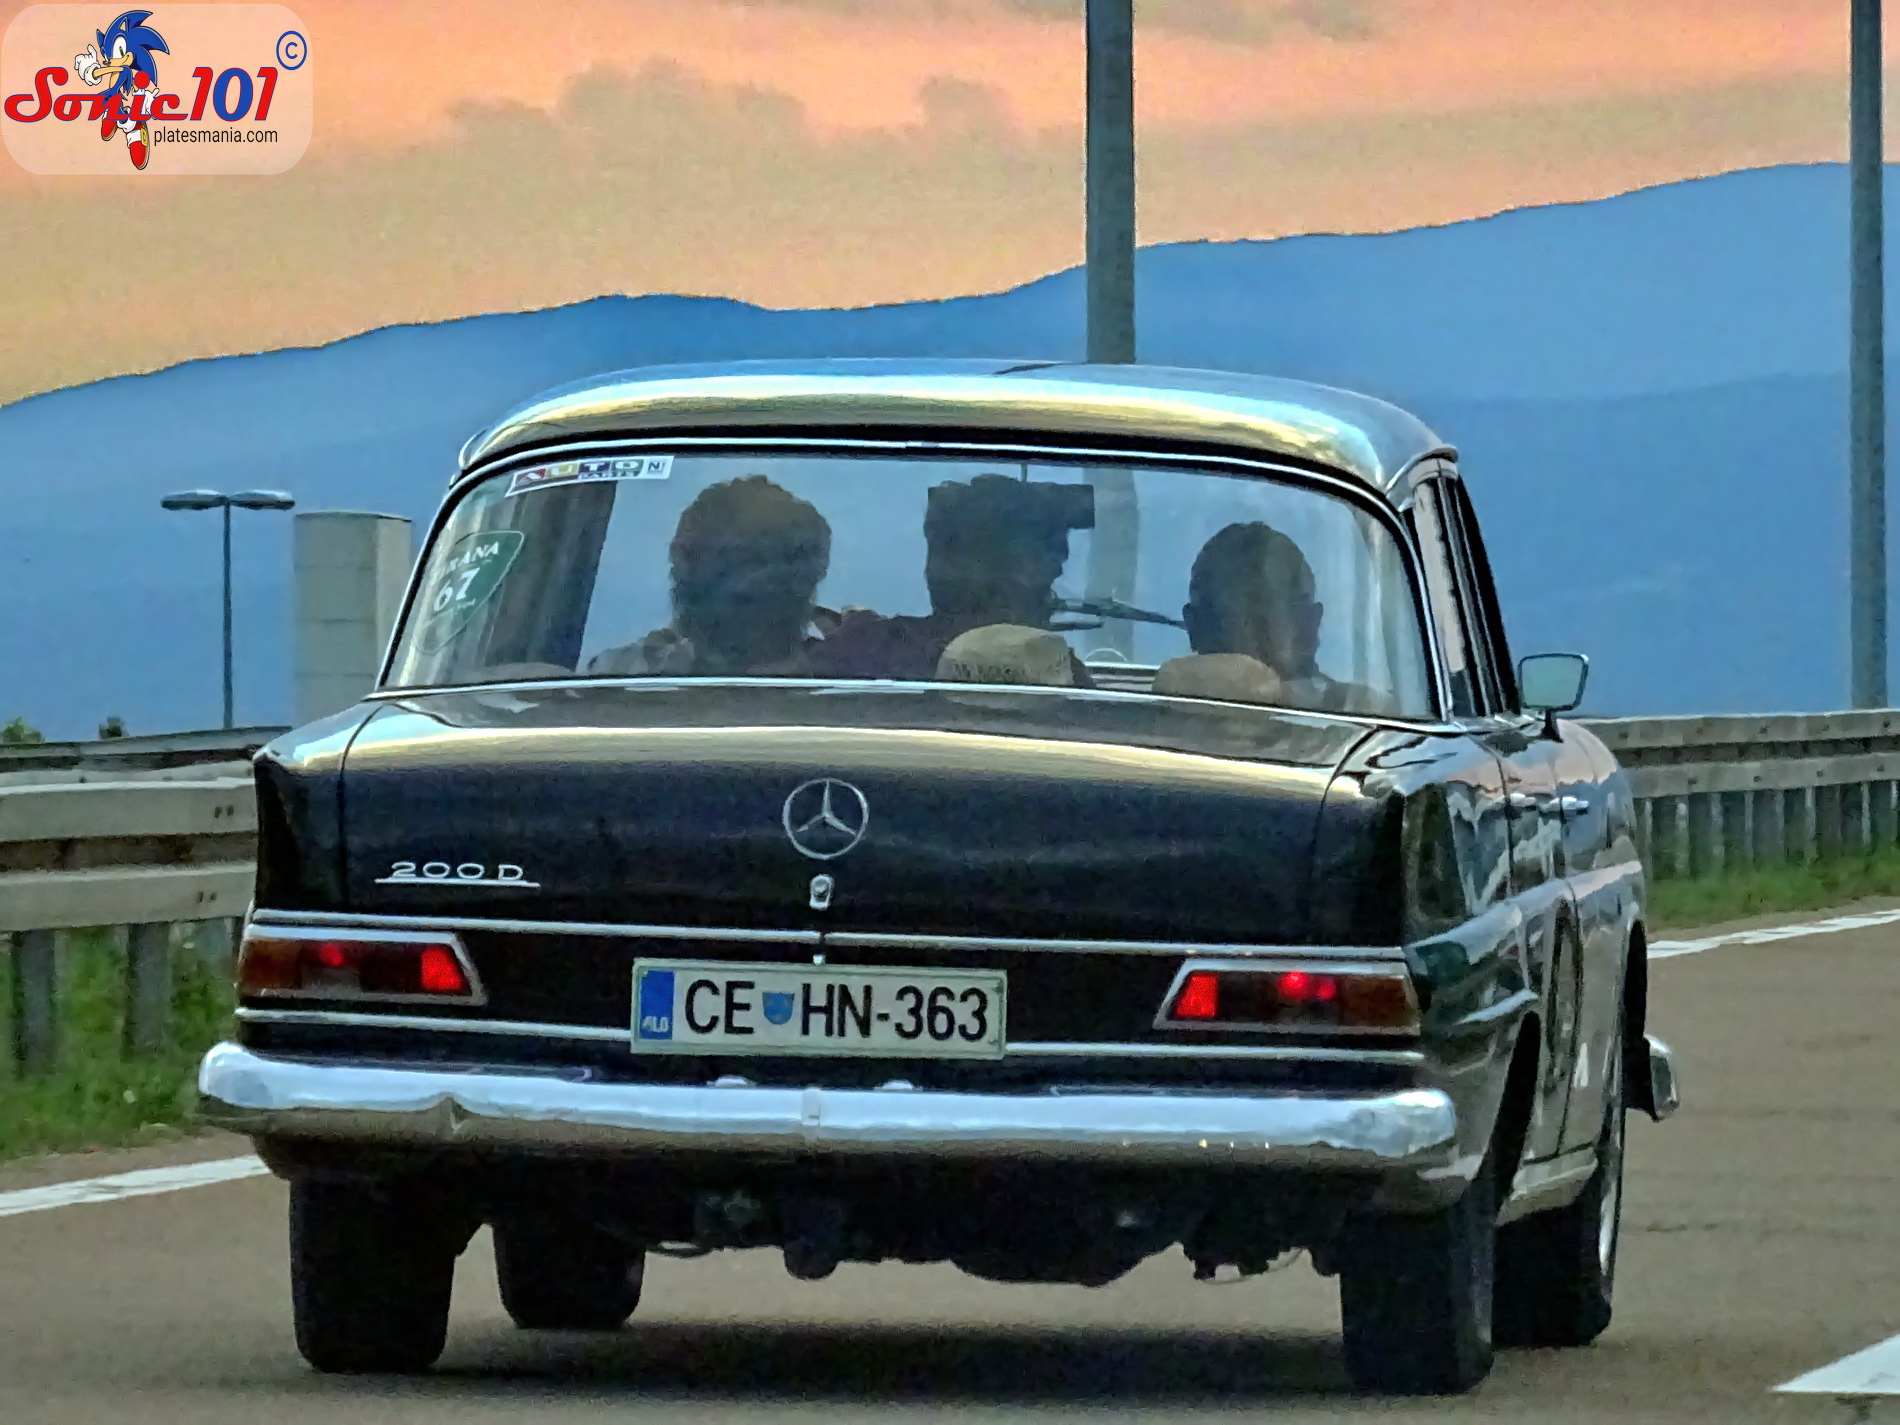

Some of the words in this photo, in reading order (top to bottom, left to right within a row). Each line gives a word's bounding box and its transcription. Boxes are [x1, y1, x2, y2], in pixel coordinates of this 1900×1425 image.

[391, 861, 485, 879] 200
[498, 863, 523, 880] D
[684, 979, 755, 1035] CE
[801, 981, 988, 1042] HN-363
